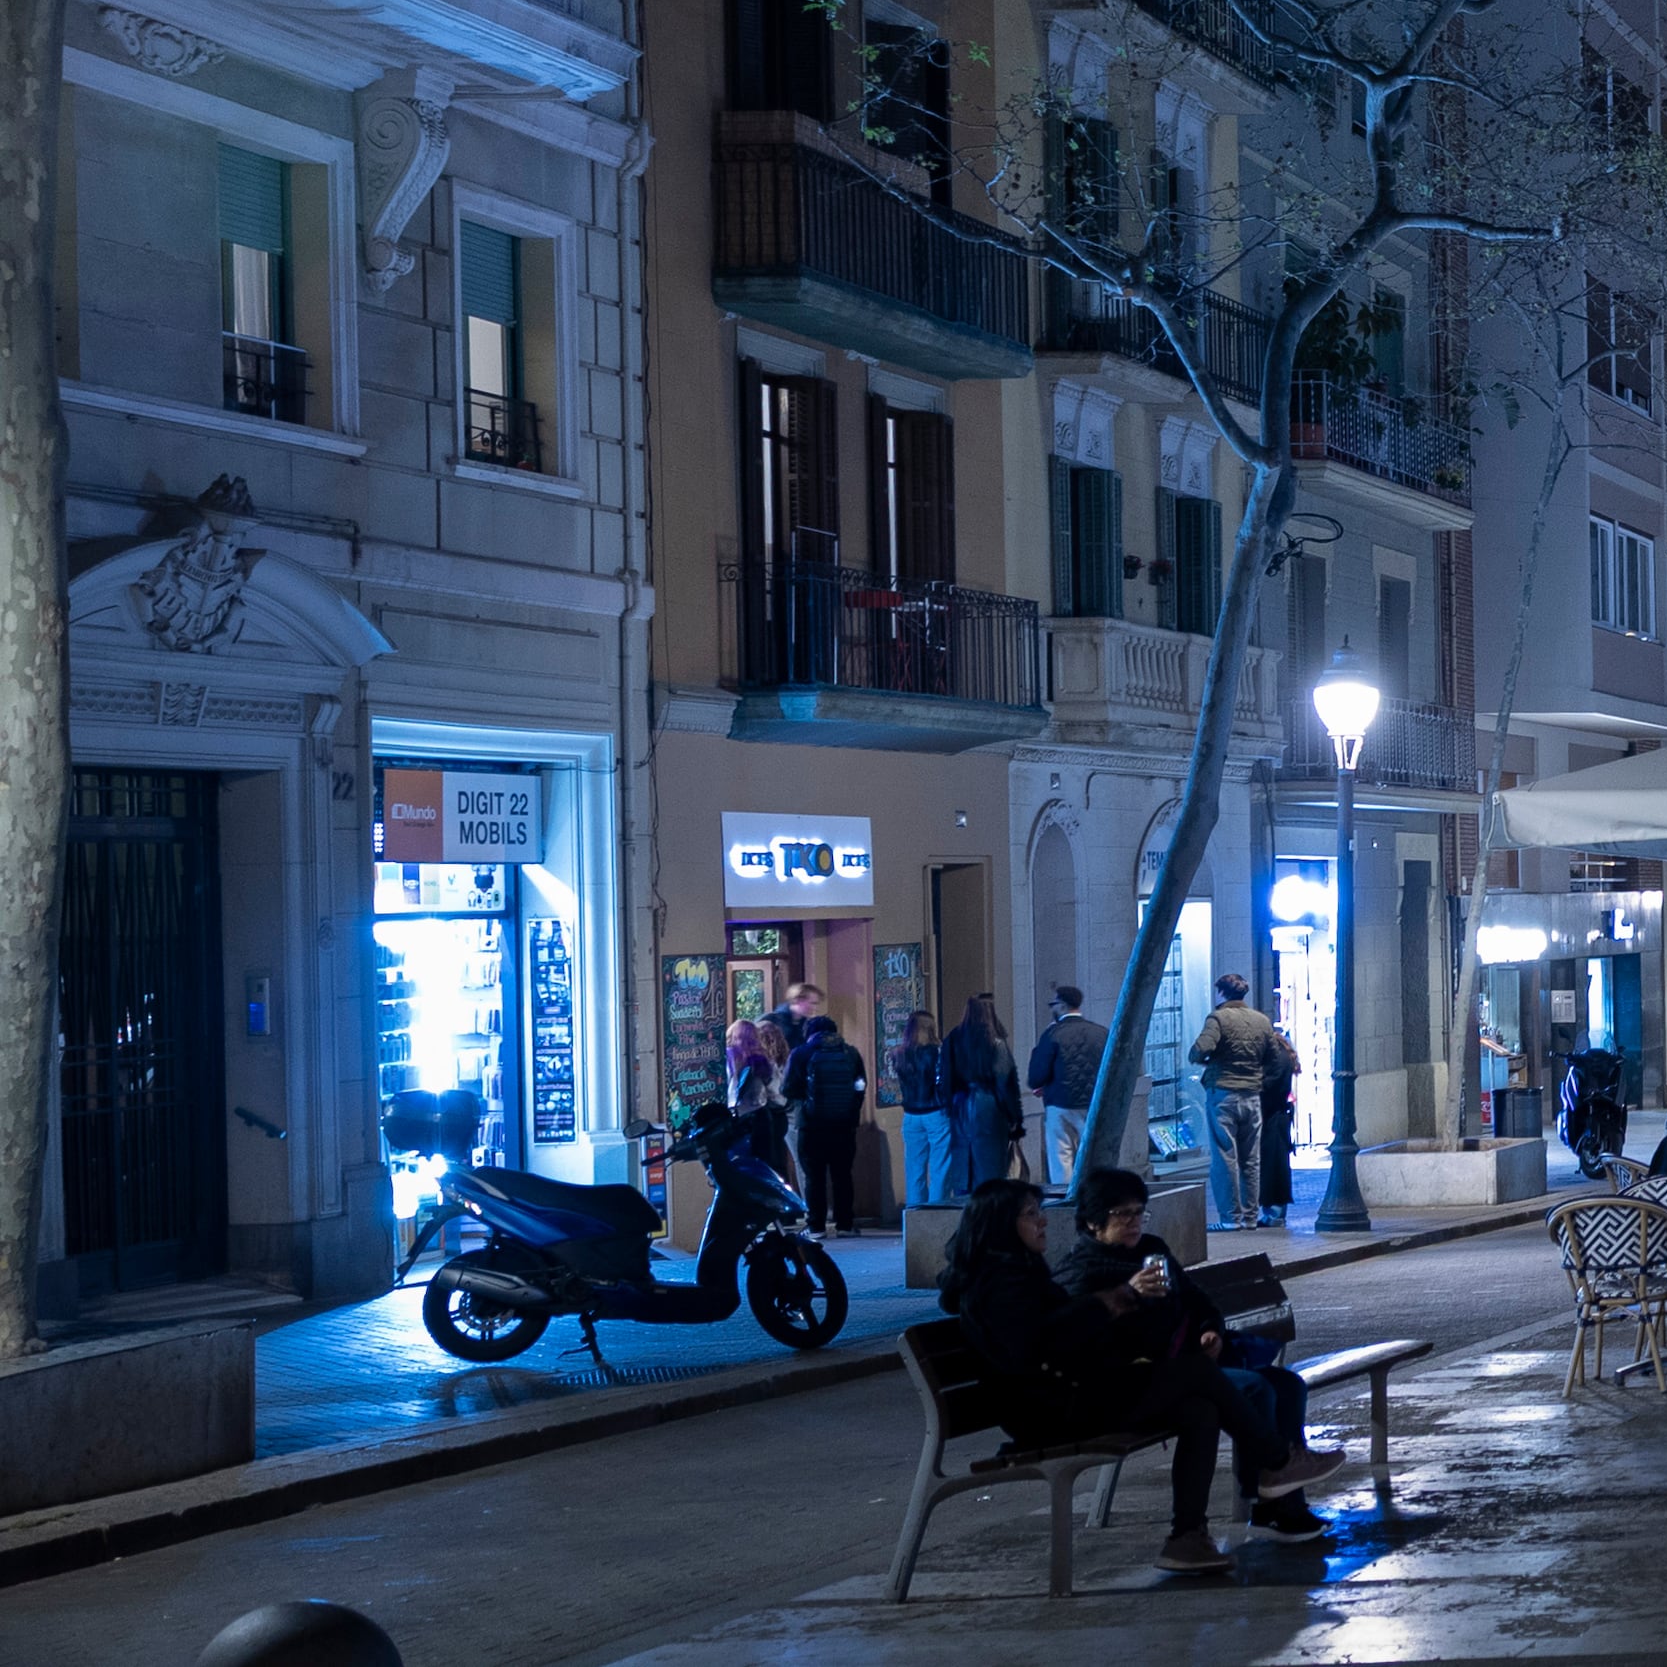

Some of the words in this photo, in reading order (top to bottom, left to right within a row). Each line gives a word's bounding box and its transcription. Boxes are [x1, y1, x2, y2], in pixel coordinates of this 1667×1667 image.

[457, 791, 505, 815] DIGIT
[509, 793, 529, 816] 22
[459, 821, 528, 845] MOBILS
[779, 842, 834, 877] TKO
